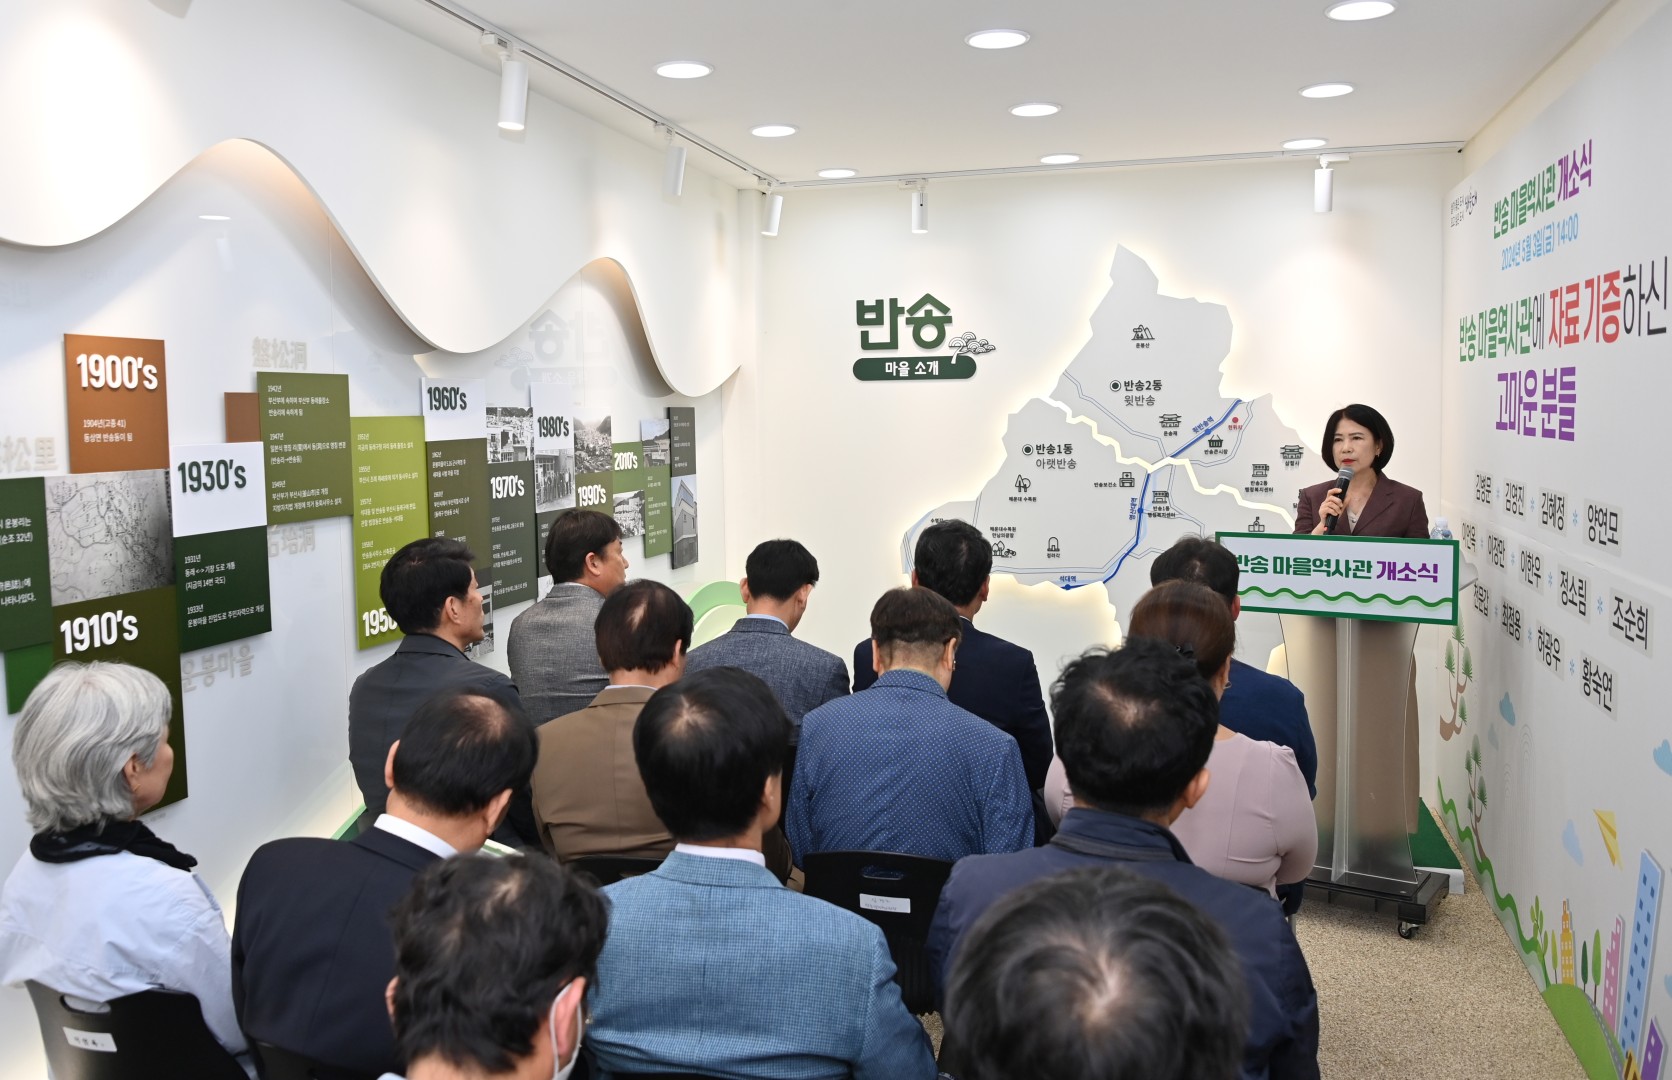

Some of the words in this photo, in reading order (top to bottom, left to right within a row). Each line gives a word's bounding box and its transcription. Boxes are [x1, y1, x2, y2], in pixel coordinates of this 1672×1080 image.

[1493, 195, 1508, 239] 반송
[1510, 163, 1555, 227] 마을역사관
[1557, 138, 1593, 202] 개소식
[1502, 238, 1521, 271] 2024년
[1522, 233, 1532, 262] 5월
[1533, 224, 1555, 258] 3일(금)
[1556, 213, 1579, 246] 14:00
[855, 293, 953, 351] 반송
[1459, 314, 1477, 362] 반송
[1478, 292, 1545, 358] 마을역사관에
[1548, 281, 1580, 349] 자료
[1583, 255, 1667, 344] 기증하신
[76, 354, 158, 390] 1900's
[885, 361, 910, 377] 마을
[914, 360, 939, 376] 소개
[427, 386, 467, 411] 1960's
[1124, 379, 1162, 392] 반송2동
[1124, 395, 1156, 407] 윗반송
[1496, 368, 1538, 437] 고마운
[1541, 366, 1577, 441] 분들
[537, 416, 569, 438] 1980's
[0, 435, 60, 474] 松里
[614, 451, 638, 470] 2010's
[1035, 443, 1073, 455] 반송1동
[1035, 457, 1077, 470] 아랫반송
[177, 459, 246, 493] 1930's
[490, 474, 524, 499] 1970's
[578, 484, 606, 507] 1990's
[1505, 482, 1525, 516] 김영진
[1541, 492, 1565, 531] 김혜정
[1587, 504, 1619, 545] 양연모
[1060, 575, 1076, 583] 석대역
[1236, 554, 1268, 574] 반송
[1272, 555, 1373, 580] 마을역사관
[1377, 560, 1438, 583] 개소식
[1488, 535, 1505, 569] 이정만
[1520, 550, 1542, 588] 이한우
[1560, 571, 1587, 617] 정소림
[1612, 596, 1648, 650] 조순희
[60, 610, 139, 654] 1910's
[1502, 601, 1521, 641] 최점용
[1537, 625, 1561, 671] 허광우
[1582, 657, 1613, 712] 황숙연
